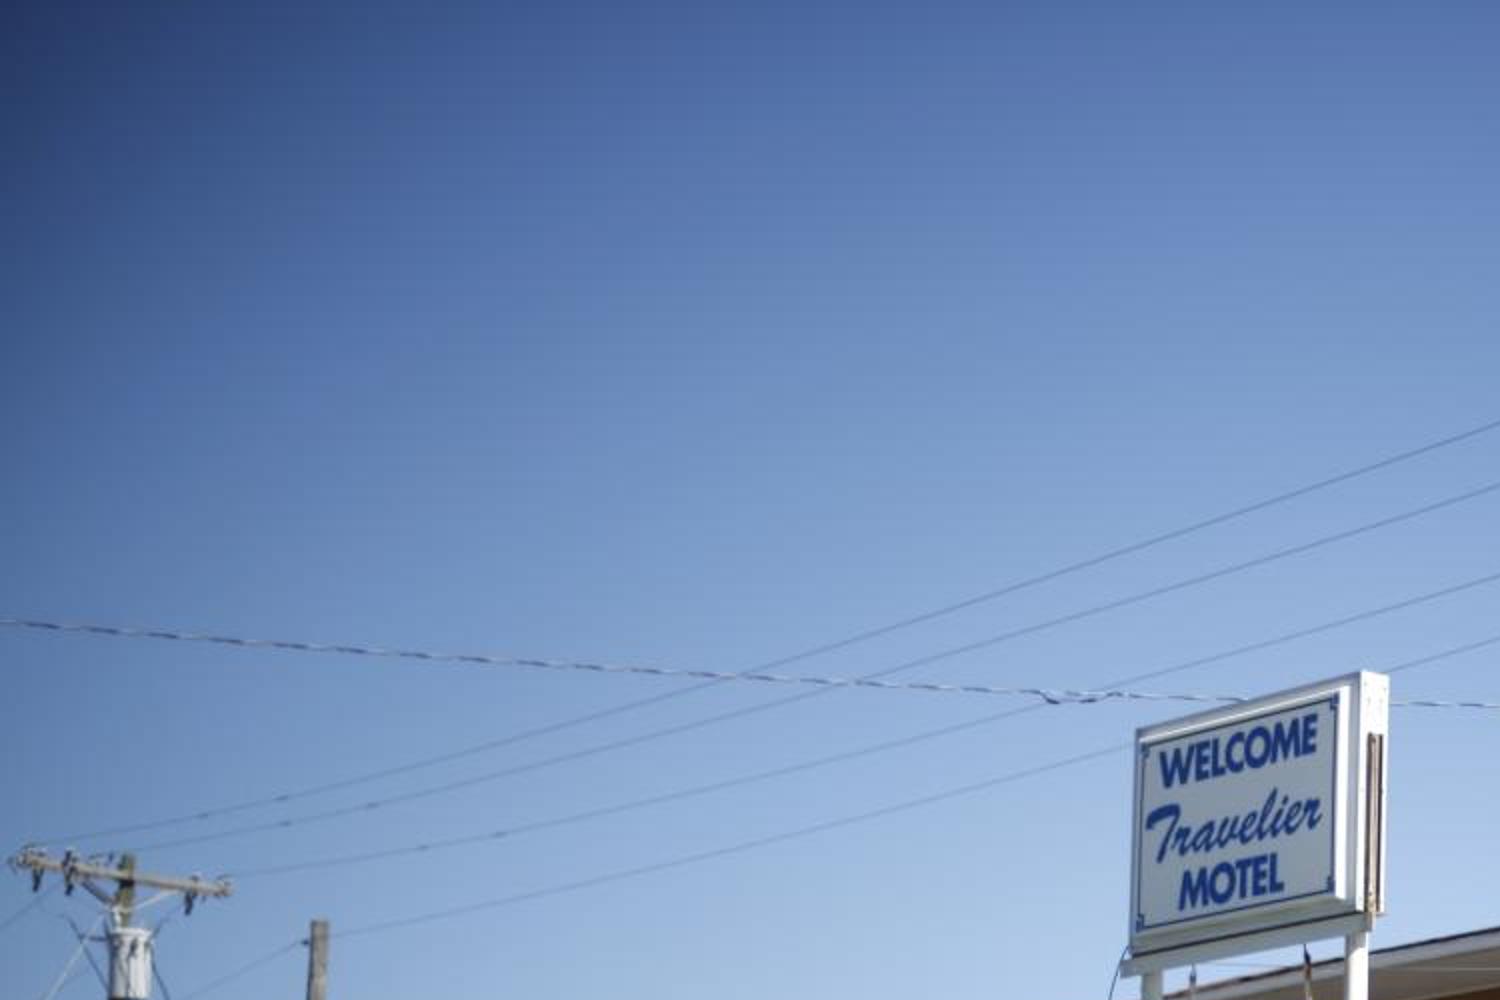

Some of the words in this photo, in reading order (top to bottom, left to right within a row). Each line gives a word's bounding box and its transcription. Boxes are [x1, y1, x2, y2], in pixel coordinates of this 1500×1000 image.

[1160, 713, 1319, 787] WELCOME
[1145, 788, 1322, 863] Travelier
[1178, 853, 1284, 911] MOTEL
